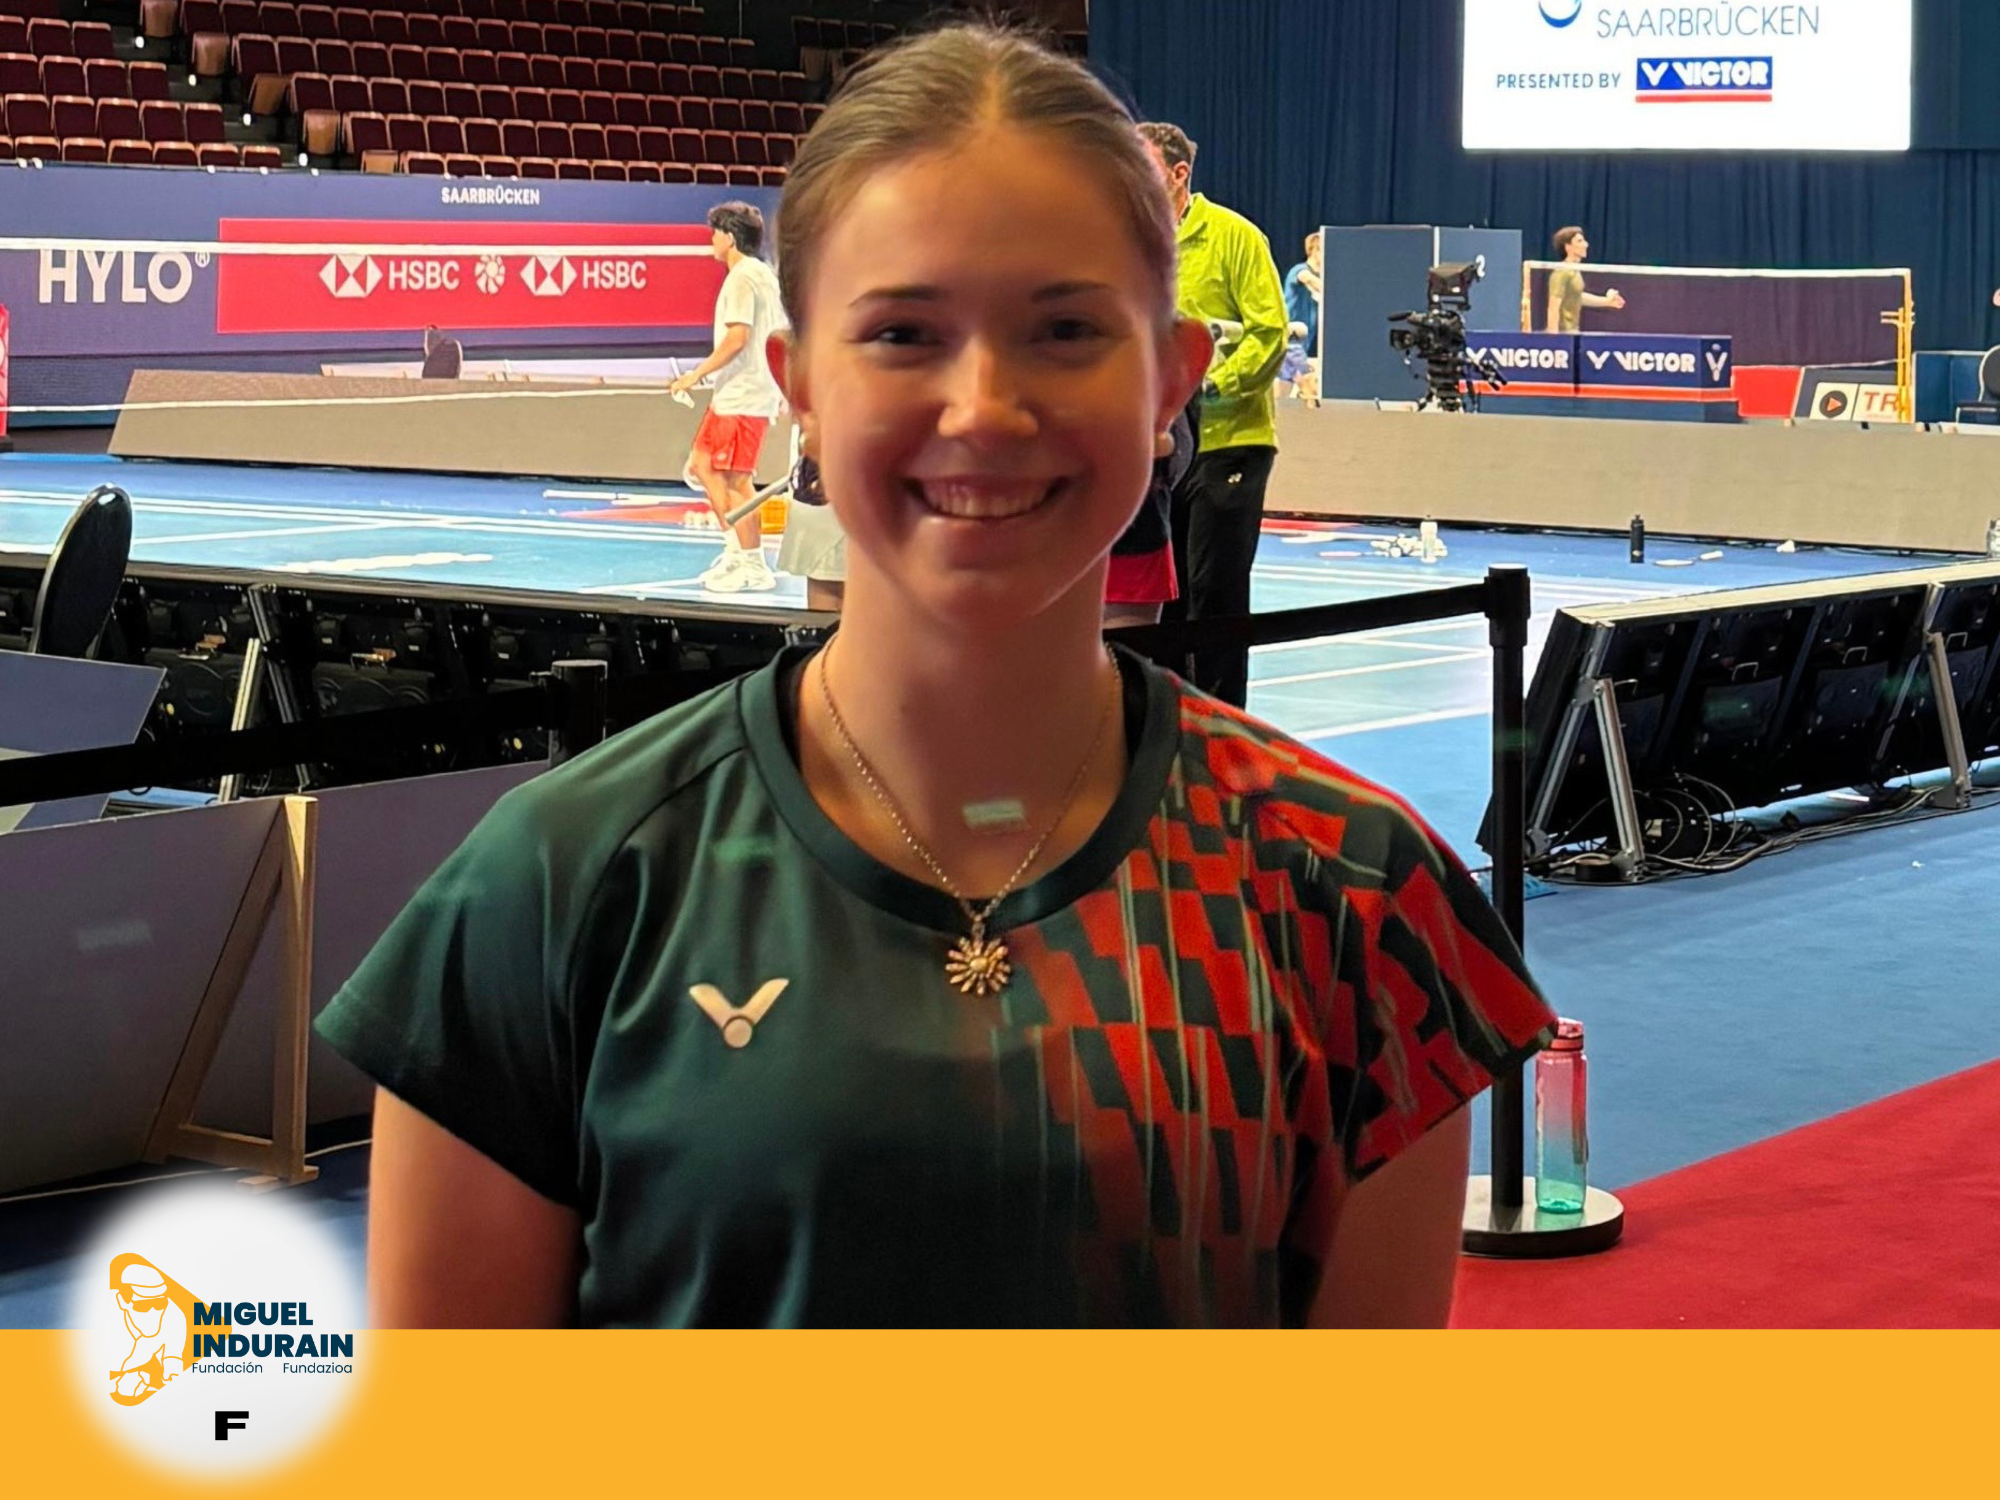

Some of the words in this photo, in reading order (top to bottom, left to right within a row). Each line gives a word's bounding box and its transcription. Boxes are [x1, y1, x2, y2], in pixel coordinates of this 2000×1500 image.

[1596, 1, 1820, 38] SAARBRÜCKEN
[1496, 73, 1594, 89] PRESENTED
[1599, 72, 1621, 88] BY
[1672, 60, 1769, 87] VICTOR
[441, 185, 540, 205] SAARBRÜCKEN
[388, 259, 460, 291] HSBC
[582, 260, 647, 290] HSBC
[1490, 348, 1569, 369] VICTOR
[1613, 350, 1695, 373] VICTOR
